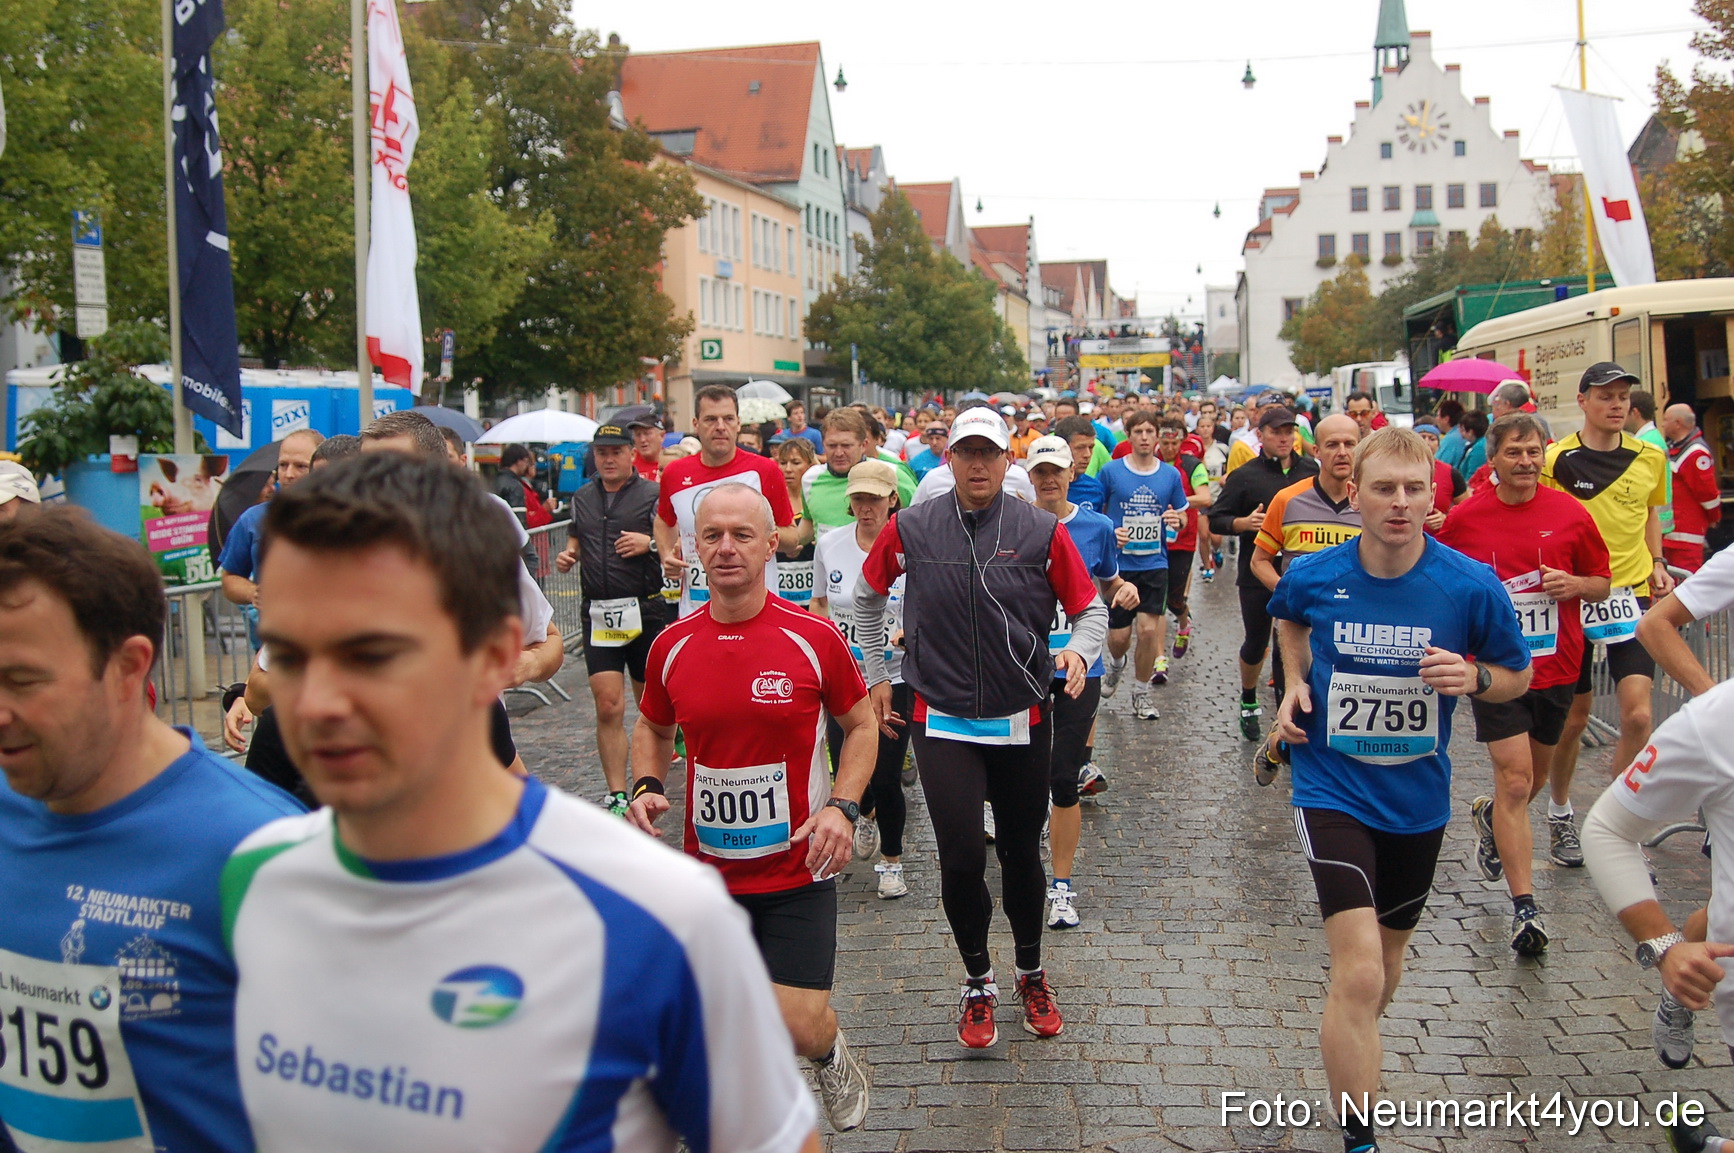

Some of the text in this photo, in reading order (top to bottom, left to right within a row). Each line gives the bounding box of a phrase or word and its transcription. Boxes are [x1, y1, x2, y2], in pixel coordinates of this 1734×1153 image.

[703, 341, 720, 359] D
[1536, 340, 1585, 365] Bayerisches
[1574, 480, 1594, 489] Jens
[1128, 526, 1158, 540] 2025
[1300, 527, 1355, 545] MÜLLE
[778, 572, 814, 589] 2388
[603, 611, 623, 628] 57
[1583, 599, 1633, 624] 2666
[1334, 621, 1432, 648] HUBER
[1603, 626, 1622, 636] Jens
[1353, 645, 1426, 656] TECHNOLOGY
[1526, 639, 1544, 648] ang
[1353, 656, 1375, 664] WASTE
[1331, 682, 1418, 695] PARTL Neumarkt
[1339, 697, 1427, 731] 2759
[1355, 740, 1409, 753] Thomas
[1624, 745, 1658, 793] 2
[696, 774, 769, 786] PARTL Neumarkt
[700, 787, 776, 824] 3001
[722, 832, 757, 846] Peter
[66, 884, 192, 920] 12. NEUMARKTER
[78, 903, 166, 930] STADTLAUF
[10, 974, 81, 1006] Neumarkt
[255, 1032, 464, 1119] Sebastian
